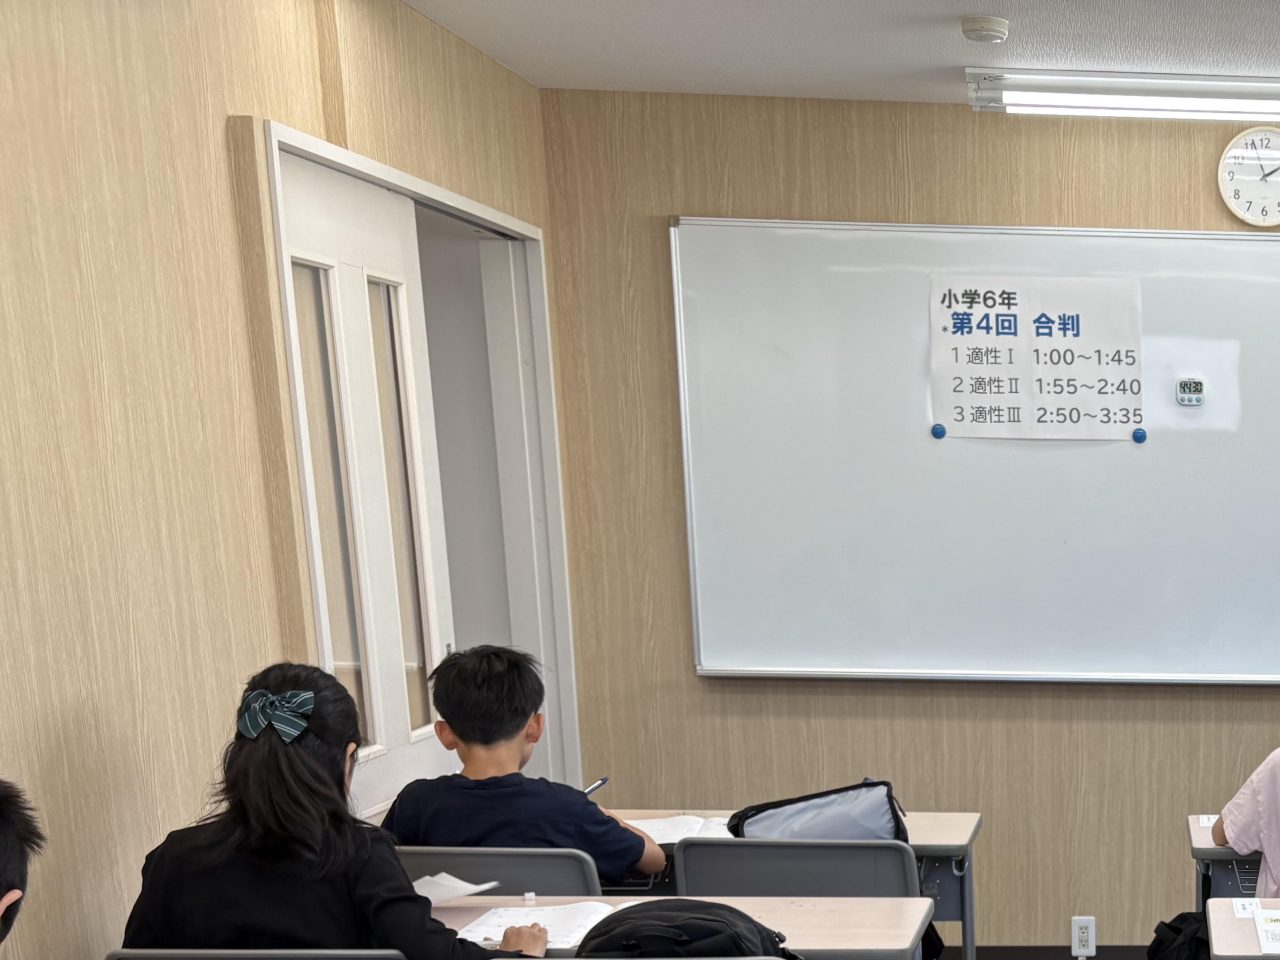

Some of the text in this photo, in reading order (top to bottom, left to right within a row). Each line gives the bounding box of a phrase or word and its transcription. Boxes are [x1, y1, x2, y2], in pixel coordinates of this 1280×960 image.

[1259, 138, 1271, 149] 12
[1228, 170, 1235, 181] 9
[1233, 189, 1240, 200] 8
[1246, 200, 1253, 212] 7
[1261, 206, 1268, 217] 6
[940, 288, 1018, 310] 小学6年
[951, 311, 1081, 338] 第4回 合判
[951, 346, 959, 364] 1
[952, 376, 964, 393] 2
[953, 405, 965, 423] 3
